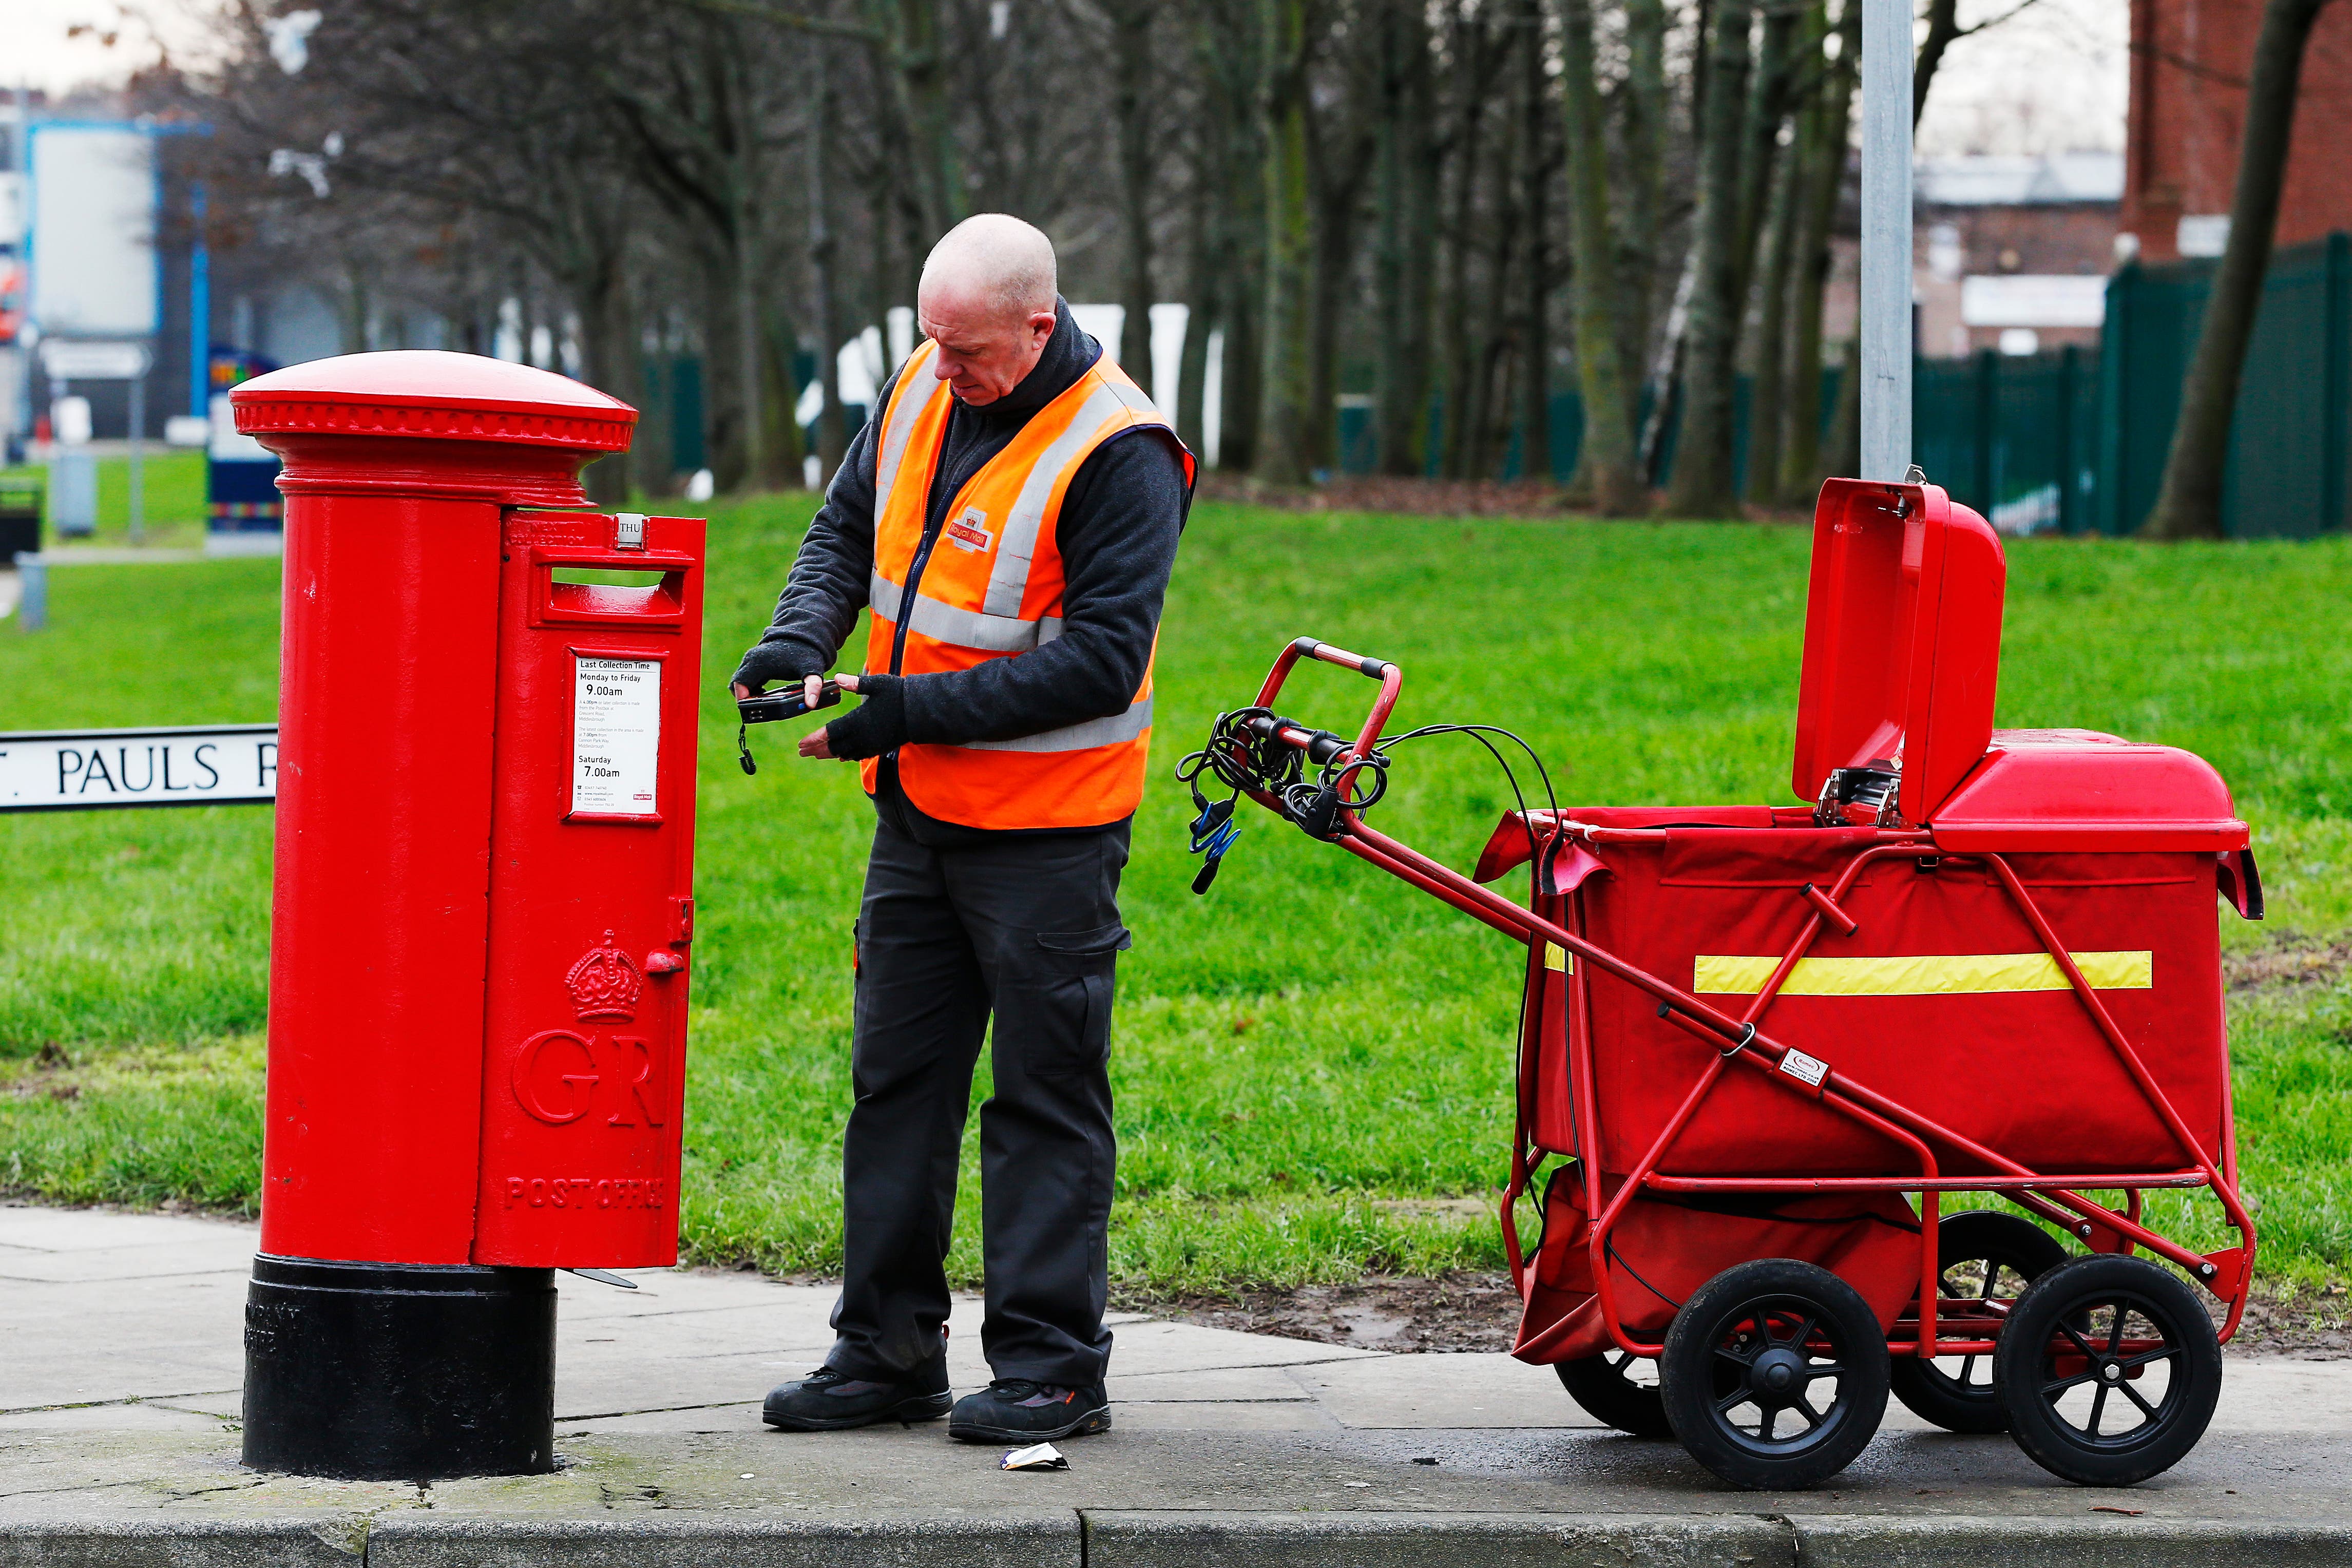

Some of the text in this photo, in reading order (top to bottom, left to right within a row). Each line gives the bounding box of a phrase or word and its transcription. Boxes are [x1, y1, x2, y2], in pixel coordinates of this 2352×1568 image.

[620, 523, 640, 532] THU
[950, 524, 984, 544] Royal Mail
[581, 674, 608, 682] Monday
[621, 674, 640, 683] Friday
[587, 684, 622, 696] 9.00am
[579, 755, 611, 764] Saturday
[57, 743, 219, 794] PAULS
[585, 766, 619, 777] 7.00am
[1783, 1066, 1798, 1075] ROMEC
[511, 1028, 664, 1127] GR
[505, 1177, 590, 1209] POST
